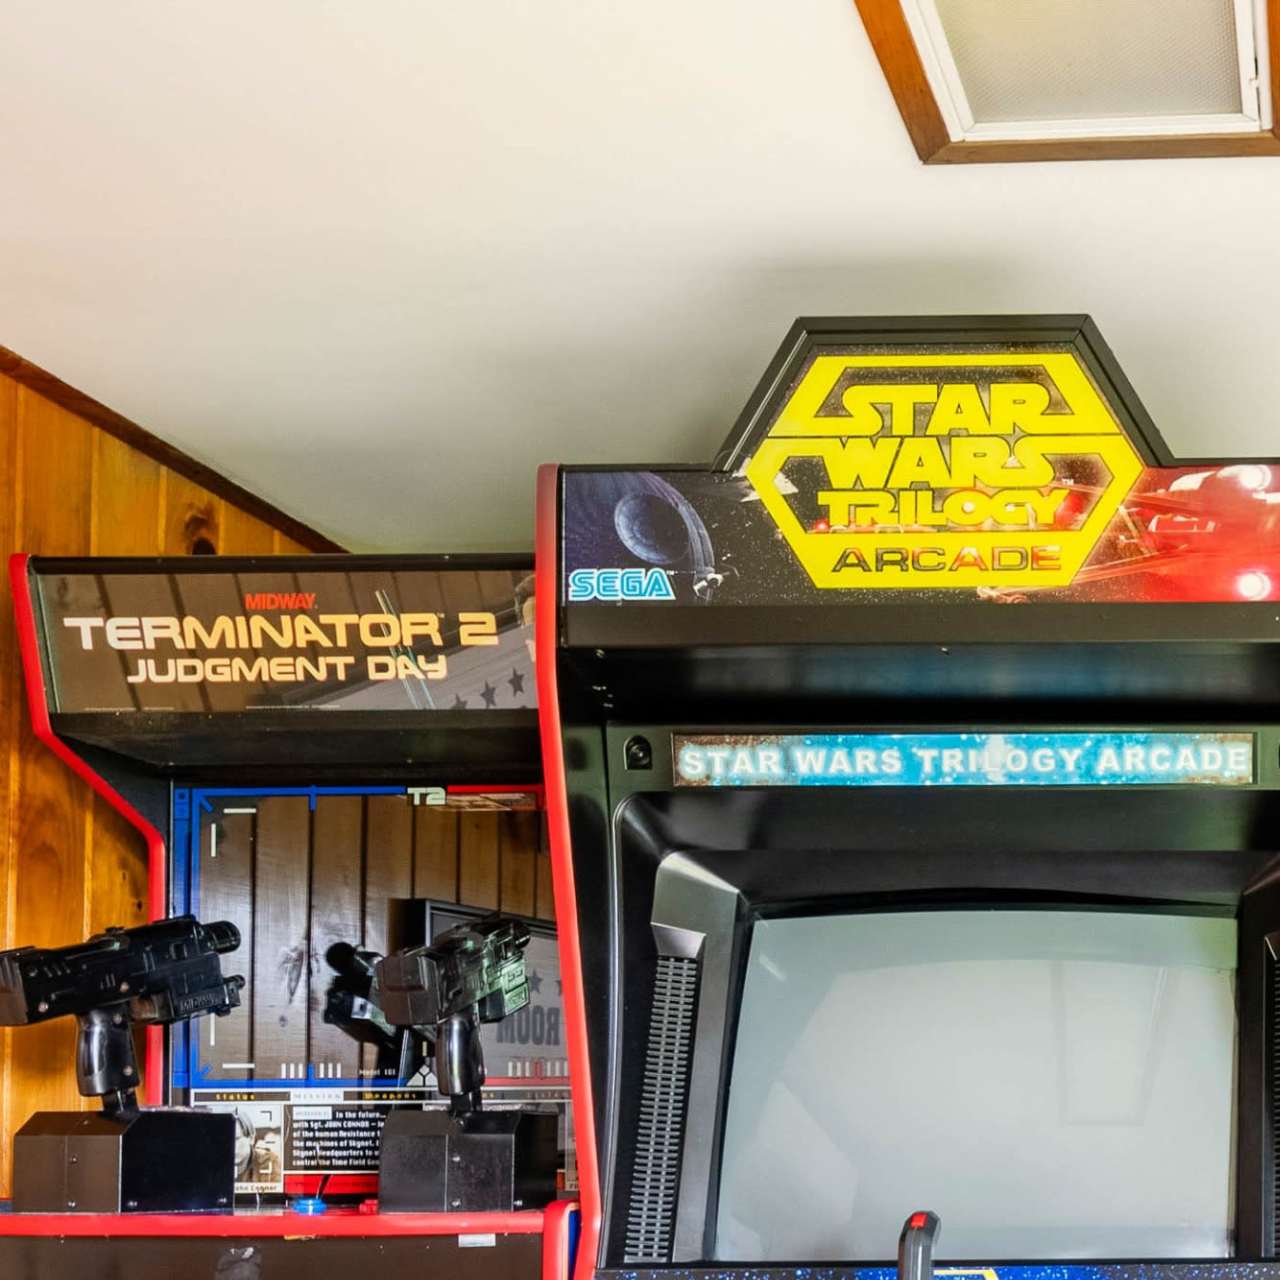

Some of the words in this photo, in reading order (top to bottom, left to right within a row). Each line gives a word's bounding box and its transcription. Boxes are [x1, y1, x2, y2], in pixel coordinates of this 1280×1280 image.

[814, 382, 1075, 436] STAR
[817, 436, 1056, 489] WARS
[816, 487, 1070, 527] TRILOGY
[831, 546, 1062, 573] ARCADE
[568, 568, 677, 601] SEGA
[63, 612, 443, 650] TERMINATOR
[459, 613, 499, 646] 2
[126, 655, 355, 685] JUDGMENT
[367, 655, 448, 681] DAY
[680, 748, 779, 776] STAR
[797, 748, 902, 775] WARS
[917, 747, 1083, 775] TRILOGY
[1096, 746, 1249, 773] ARCADE
[407, 786, 447, 806] T2
